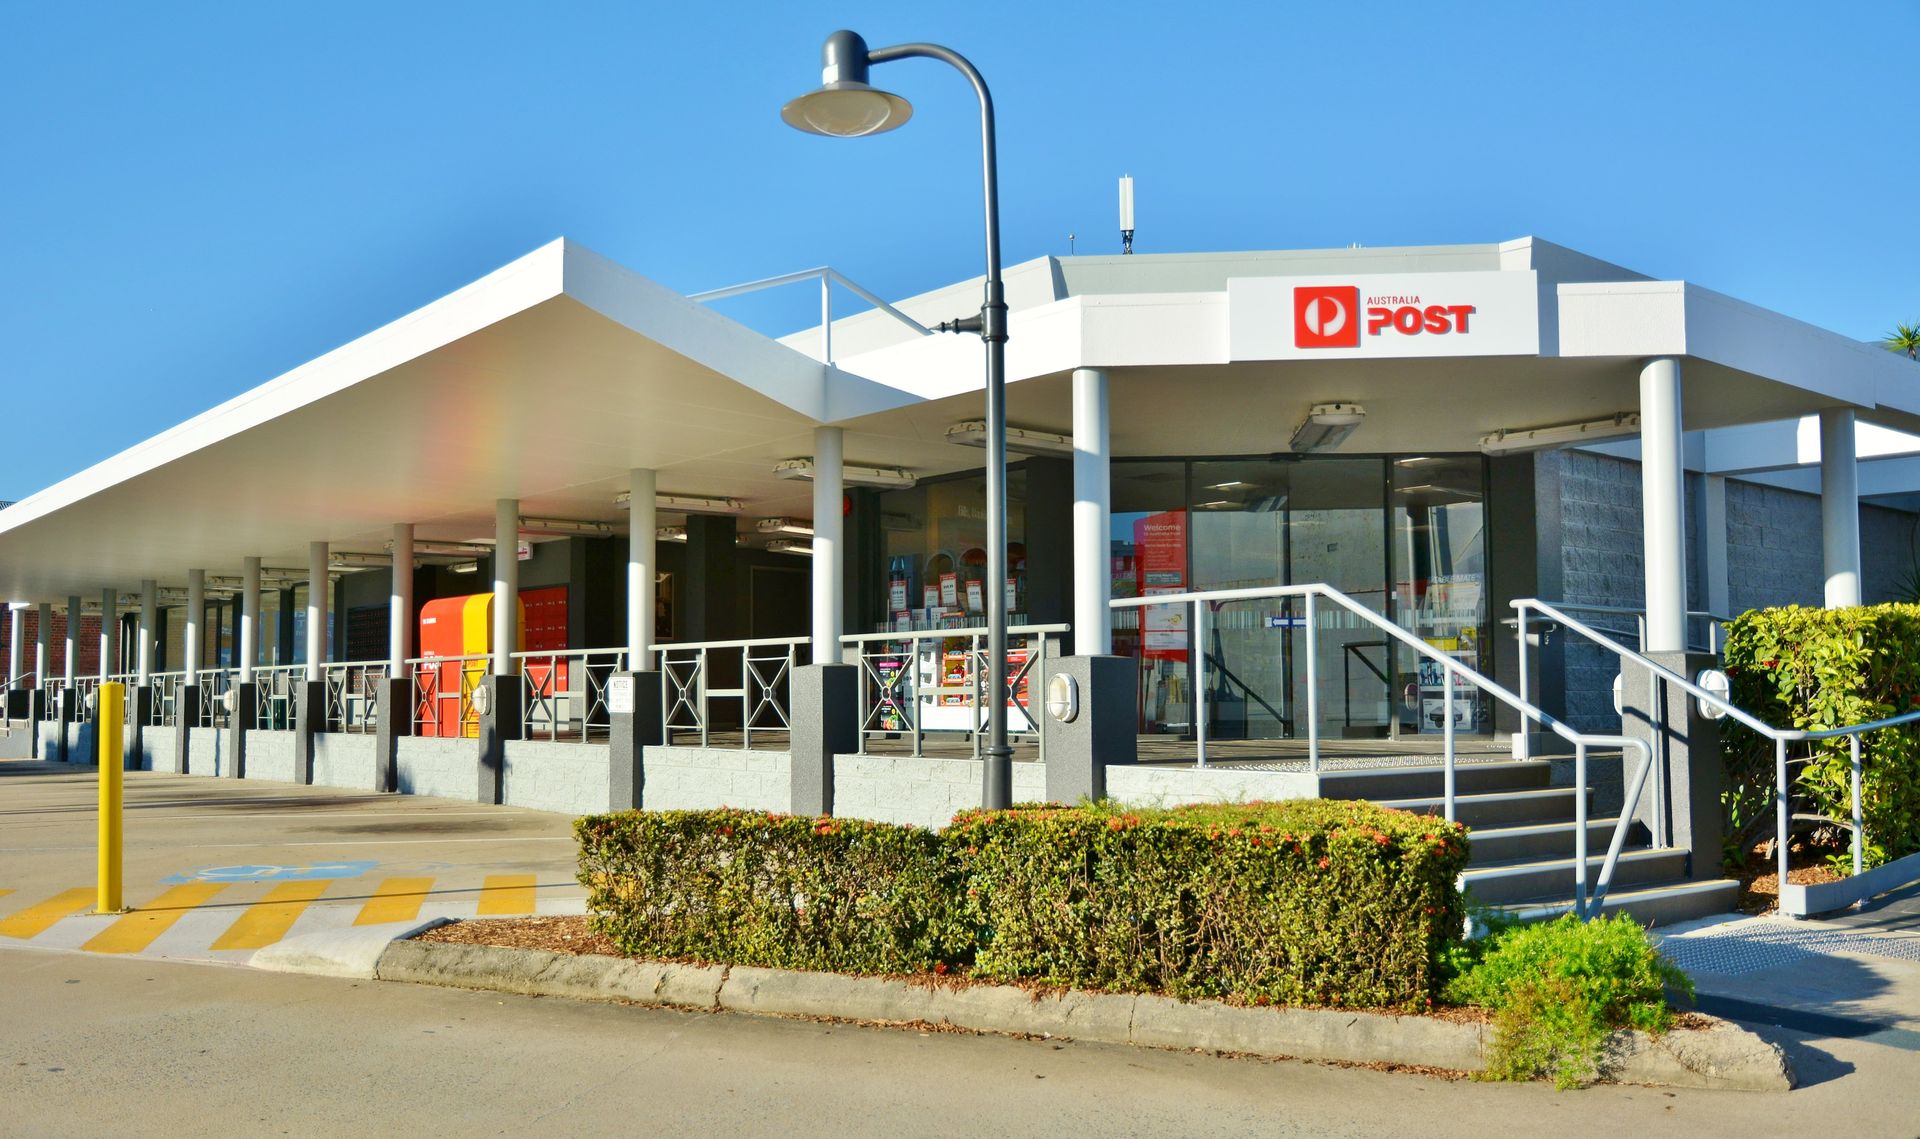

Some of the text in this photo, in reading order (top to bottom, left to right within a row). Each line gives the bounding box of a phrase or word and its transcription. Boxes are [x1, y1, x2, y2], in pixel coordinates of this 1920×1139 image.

[1367, 295, 1420, 305] AUSTRALIA
[1367, 305, 1475, 336] POST
[1143, 523, 1181, 531] Welcome
